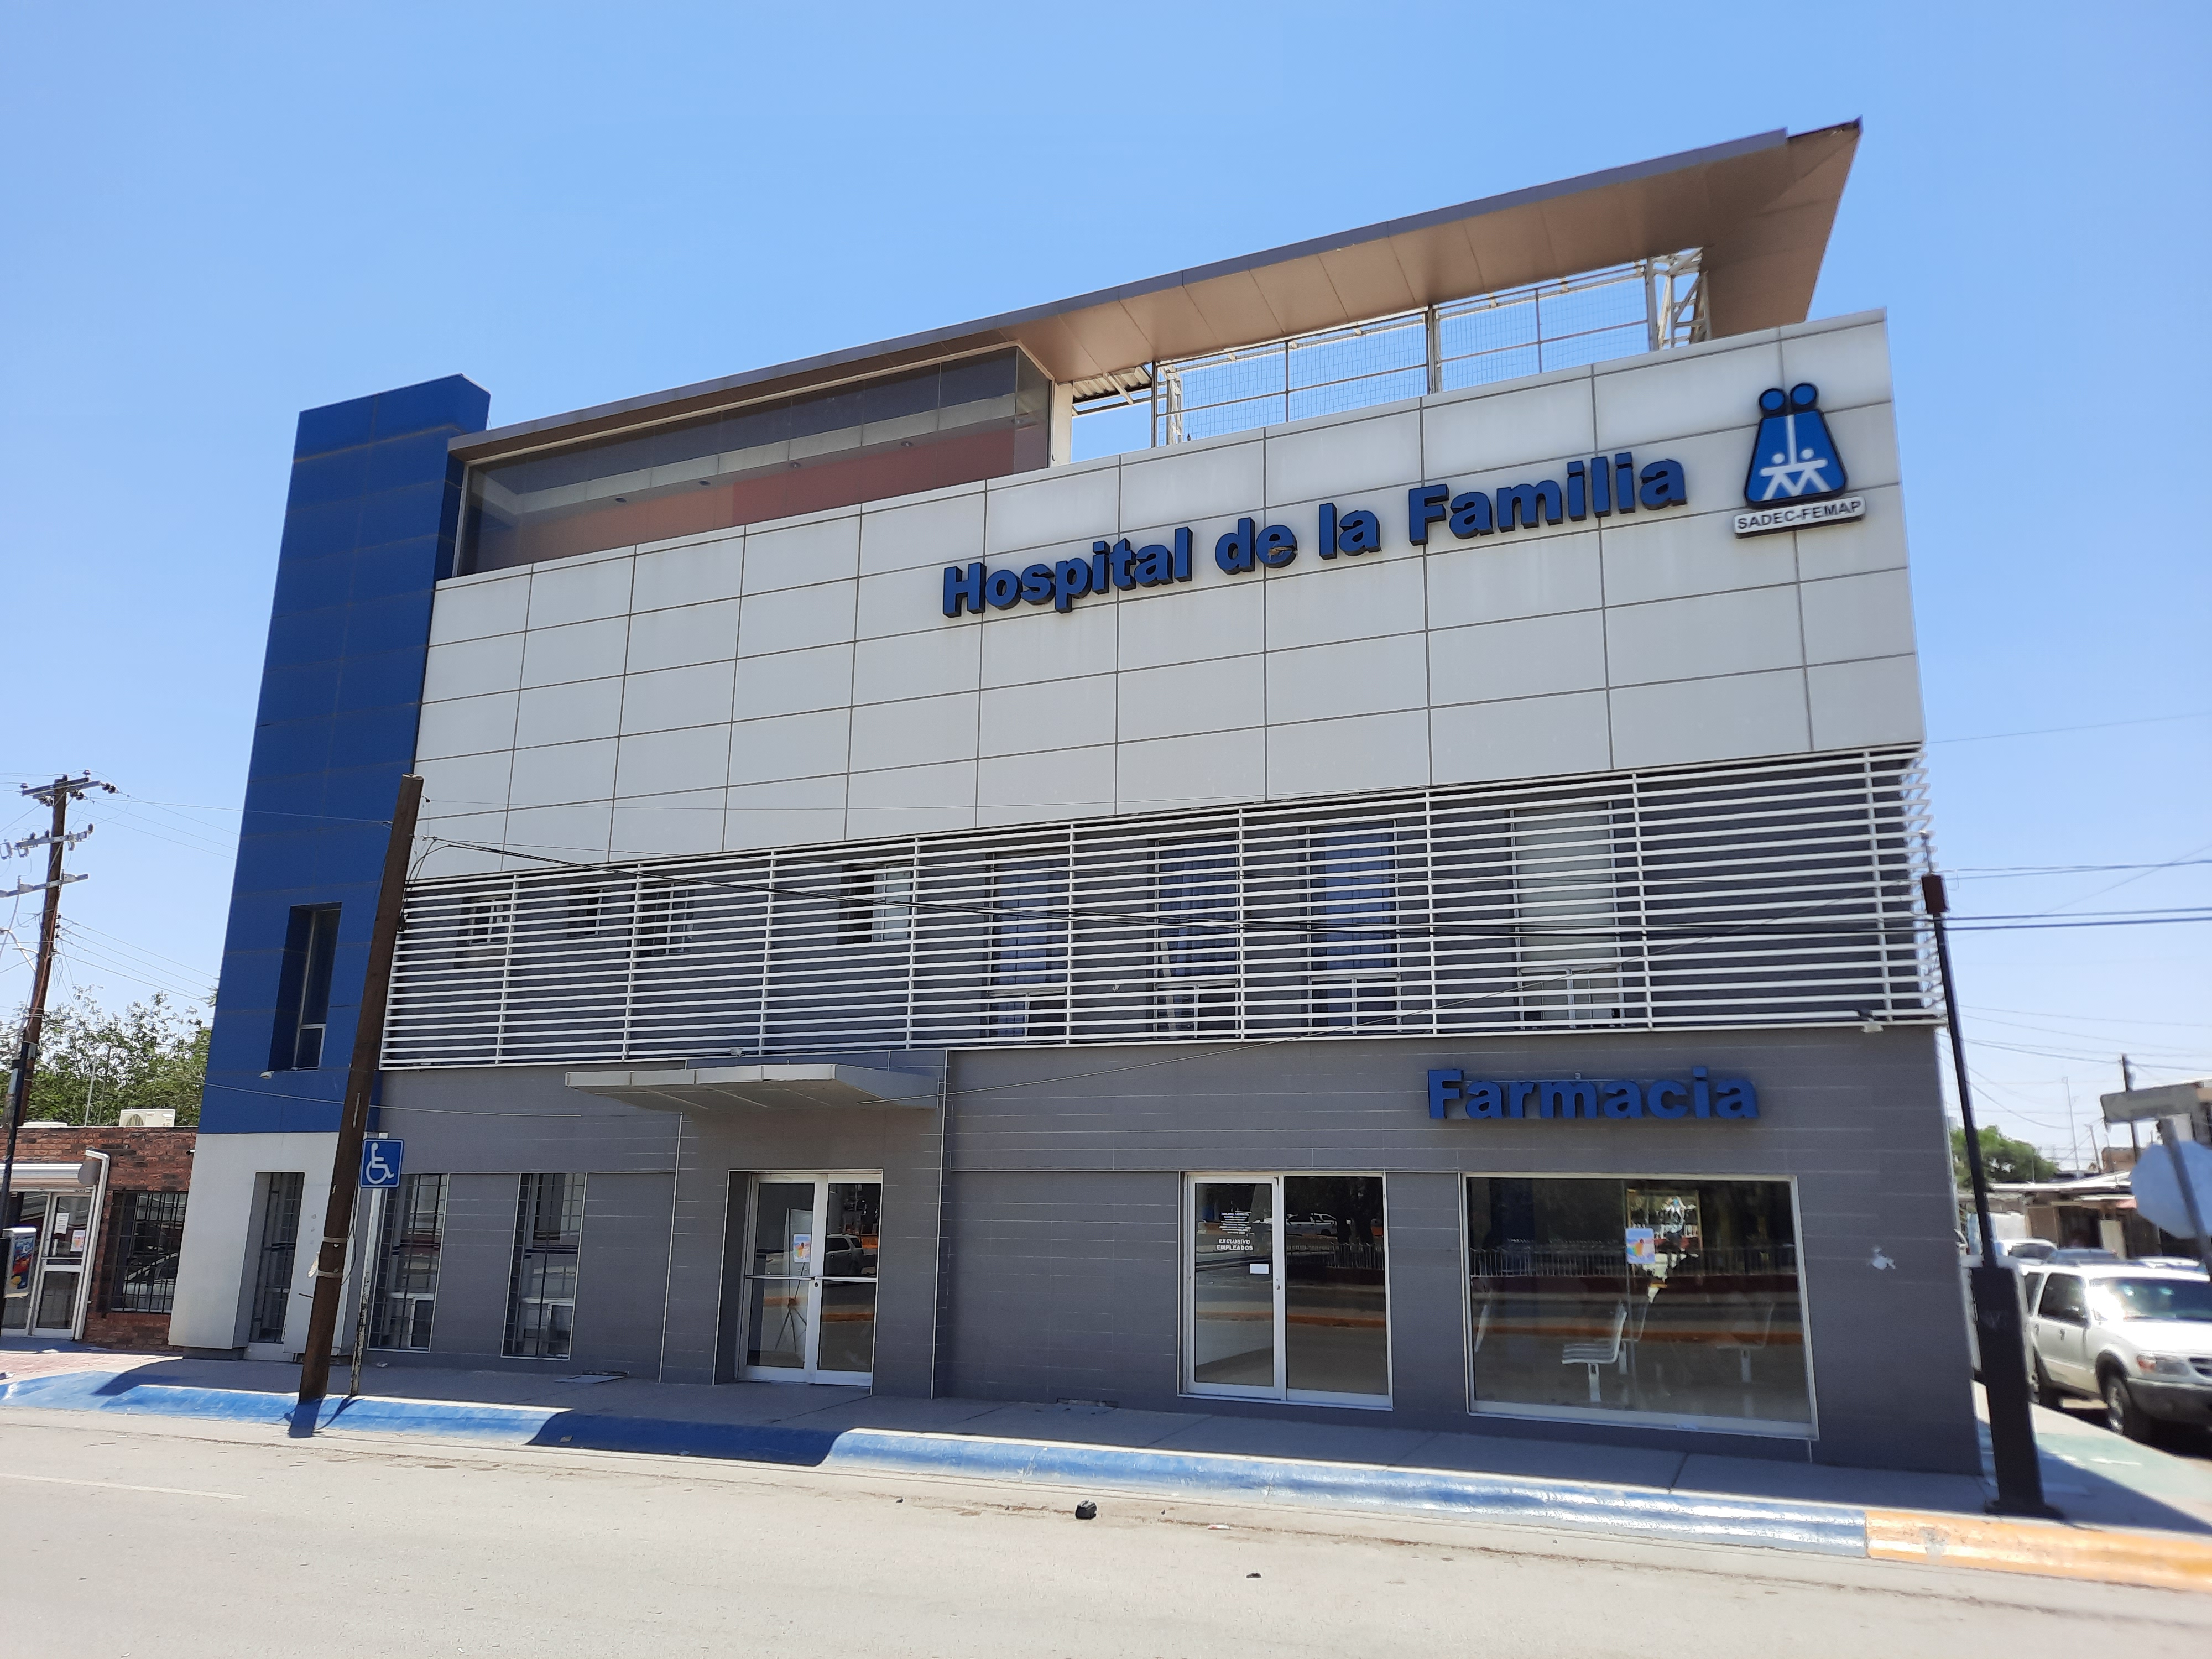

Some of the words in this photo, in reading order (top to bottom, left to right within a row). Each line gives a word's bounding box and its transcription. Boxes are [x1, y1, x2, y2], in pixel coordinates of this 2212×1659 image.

[943, 527, 1193, 618] Hospital
[1215, 517, 1297, 575] de
[1319, 503, 1381, 561] la
[1409, 452, 1687, 546] Familia
[1737, 500, 1861, 529] SADEC-FEMAP
[1427, 1066, 1759, 1119] Farmacia
